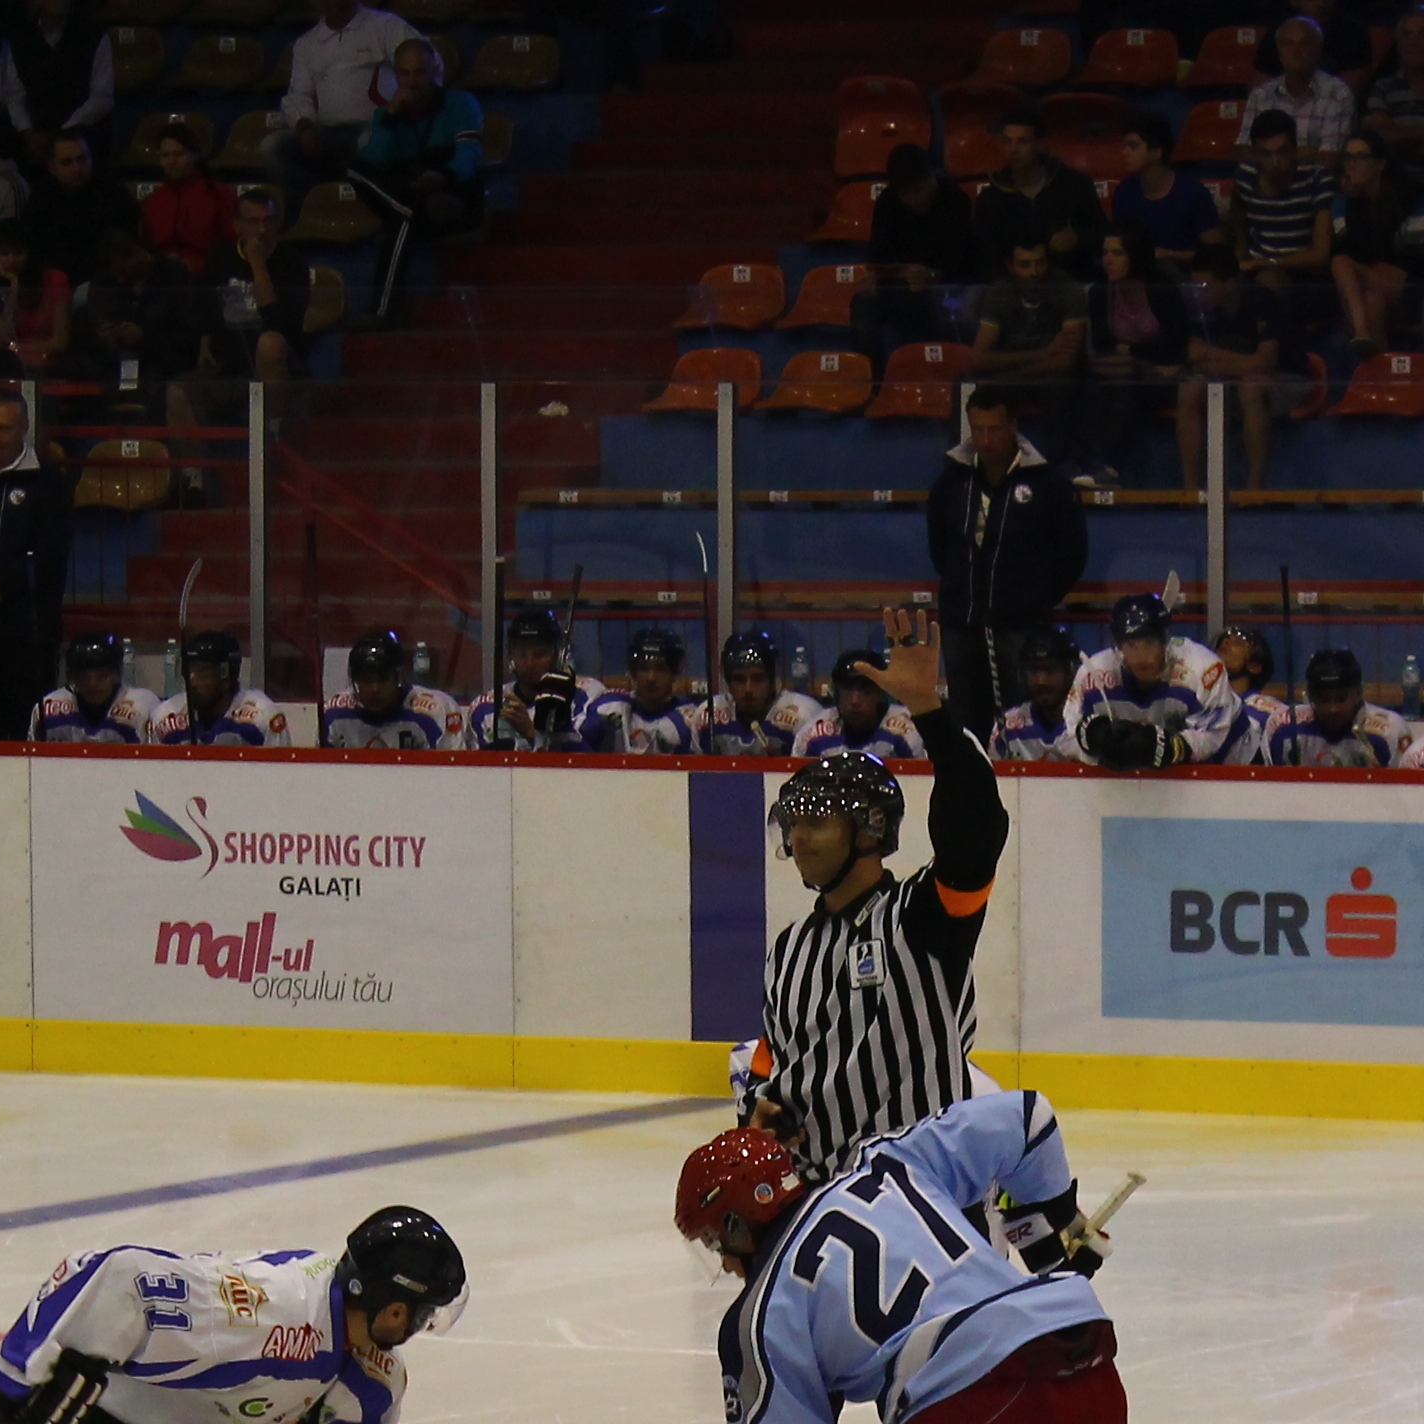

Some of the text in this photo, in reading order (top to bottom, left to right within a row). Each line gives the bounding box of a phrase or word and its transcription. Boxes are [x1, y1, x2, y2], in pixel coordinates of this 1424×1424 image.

[224, 831, 426, 869] SHOPPING CITY
[279, 875, 362, 902] GALAȚI
[1170, 889, 1311, 957] BCR
[352, 973, 394, 1003] tău
[792, 1150, 971, 1345] 27
[133, 1271, 192, 1332] 31
